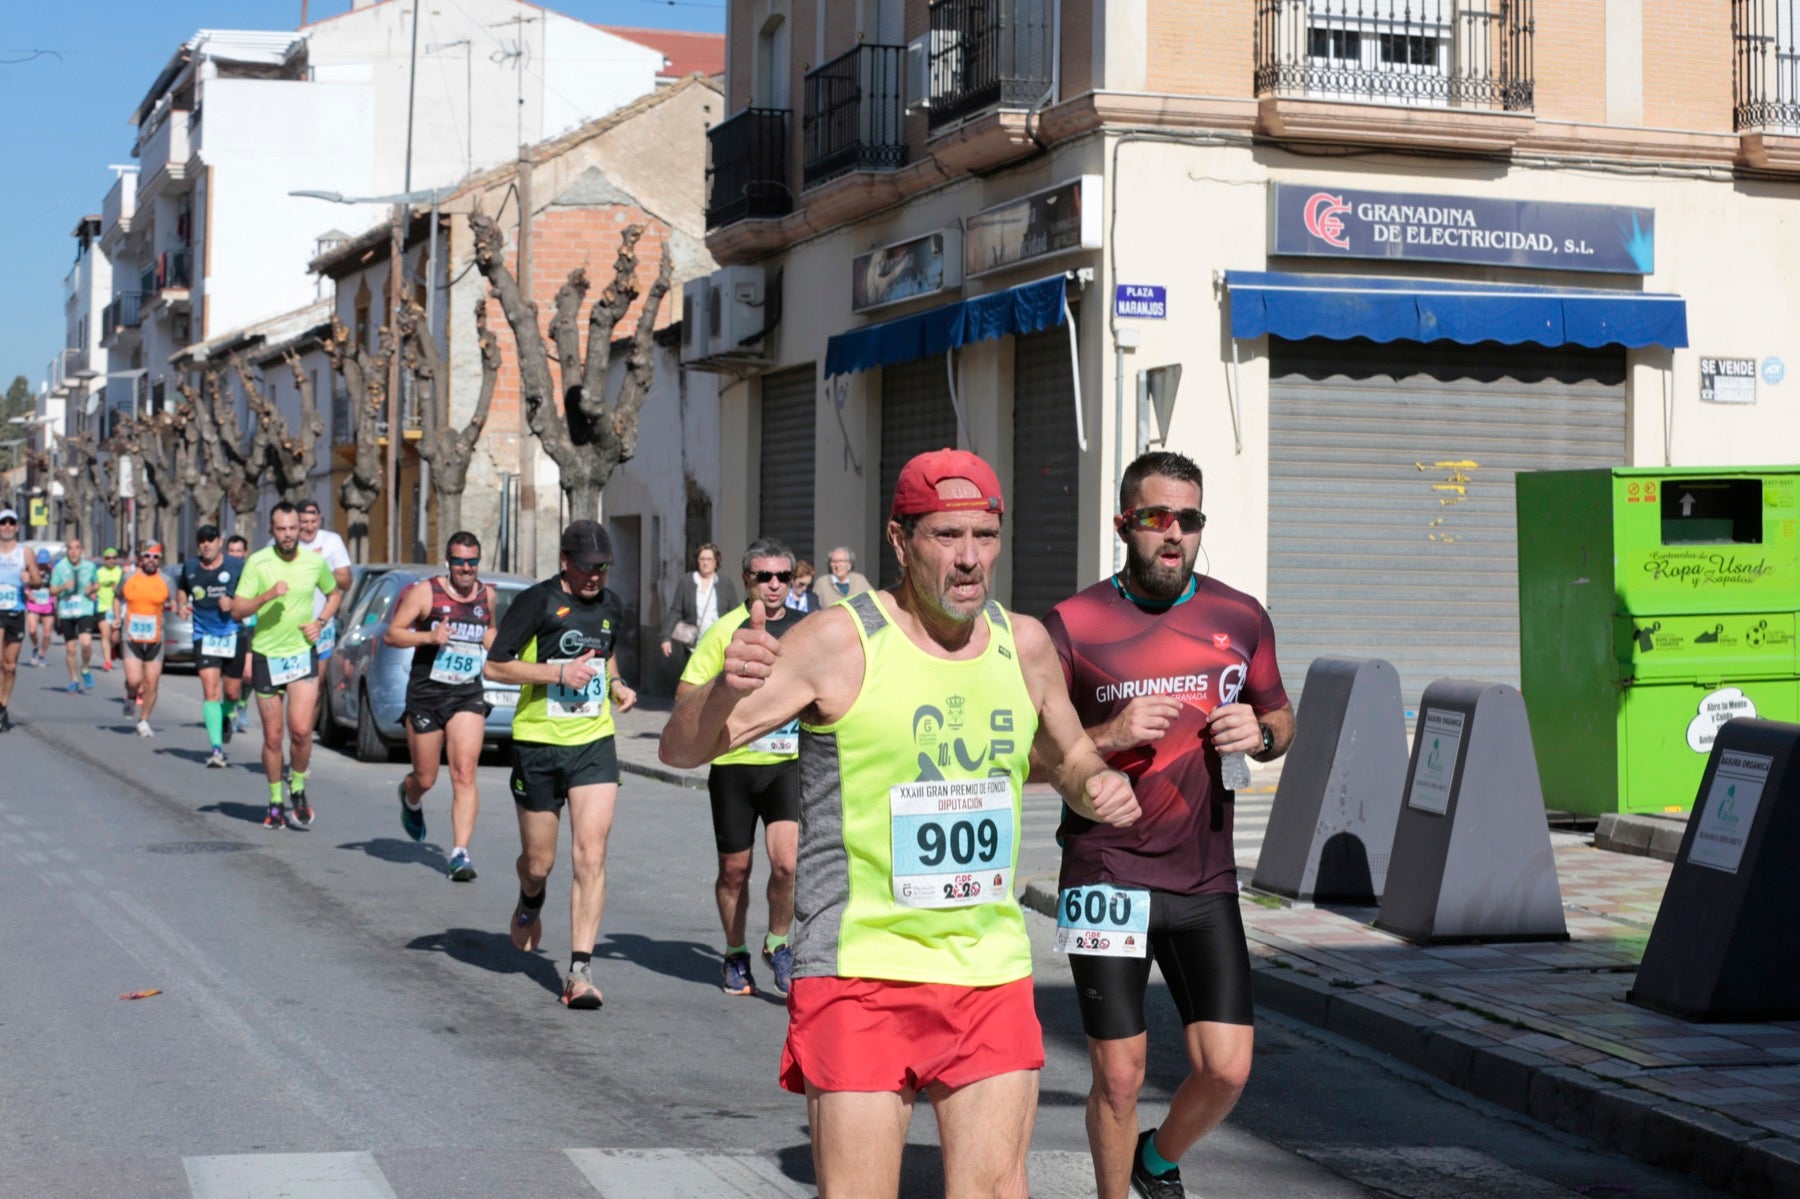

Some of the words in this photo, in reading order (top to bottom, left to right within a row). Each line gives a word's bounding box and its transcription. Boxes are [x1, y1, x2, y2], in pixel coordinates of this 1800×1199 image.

[1357, 203, 1476, 227] GRANADINA
[1373, 224, 1402, 243] DE
[1406, 226, 1558, 254] ELECTRICIDAD,
[1564, 239, 1595, 255] S.L.
[1126, 286, 1154, 298] PLAZA
[1118, 300, 1164, 316] NARANJOS
[1701, 360, 1716, 374] SE
[1718, 360, 1755, 376] VENDE
[1644, 560, 1704, 583] Ropa
[1709, 554, 1773, 576] Usada
[1691, 577, 1699, 588] y
[445, 655, 473, 672] 158
[1096, 674, 1208, 703] GINRUNNERS
[1728, 700, 1747, 709] Mente
[1721, 756, 1741, 767] BASURA
[900, 787, 924, 799] XXXIII
[926, 785, 948, 797] GRAN
[950, 783, 978, 796] PREMIO
[980, 782, 987, 793] DE
[987, 781, 1006, 793] FONDO
[938, 797, 983, 811] DIPUTACIÓN
[917, 818, 998, 867] 909
[1065, 889, 1132, 926] 600
